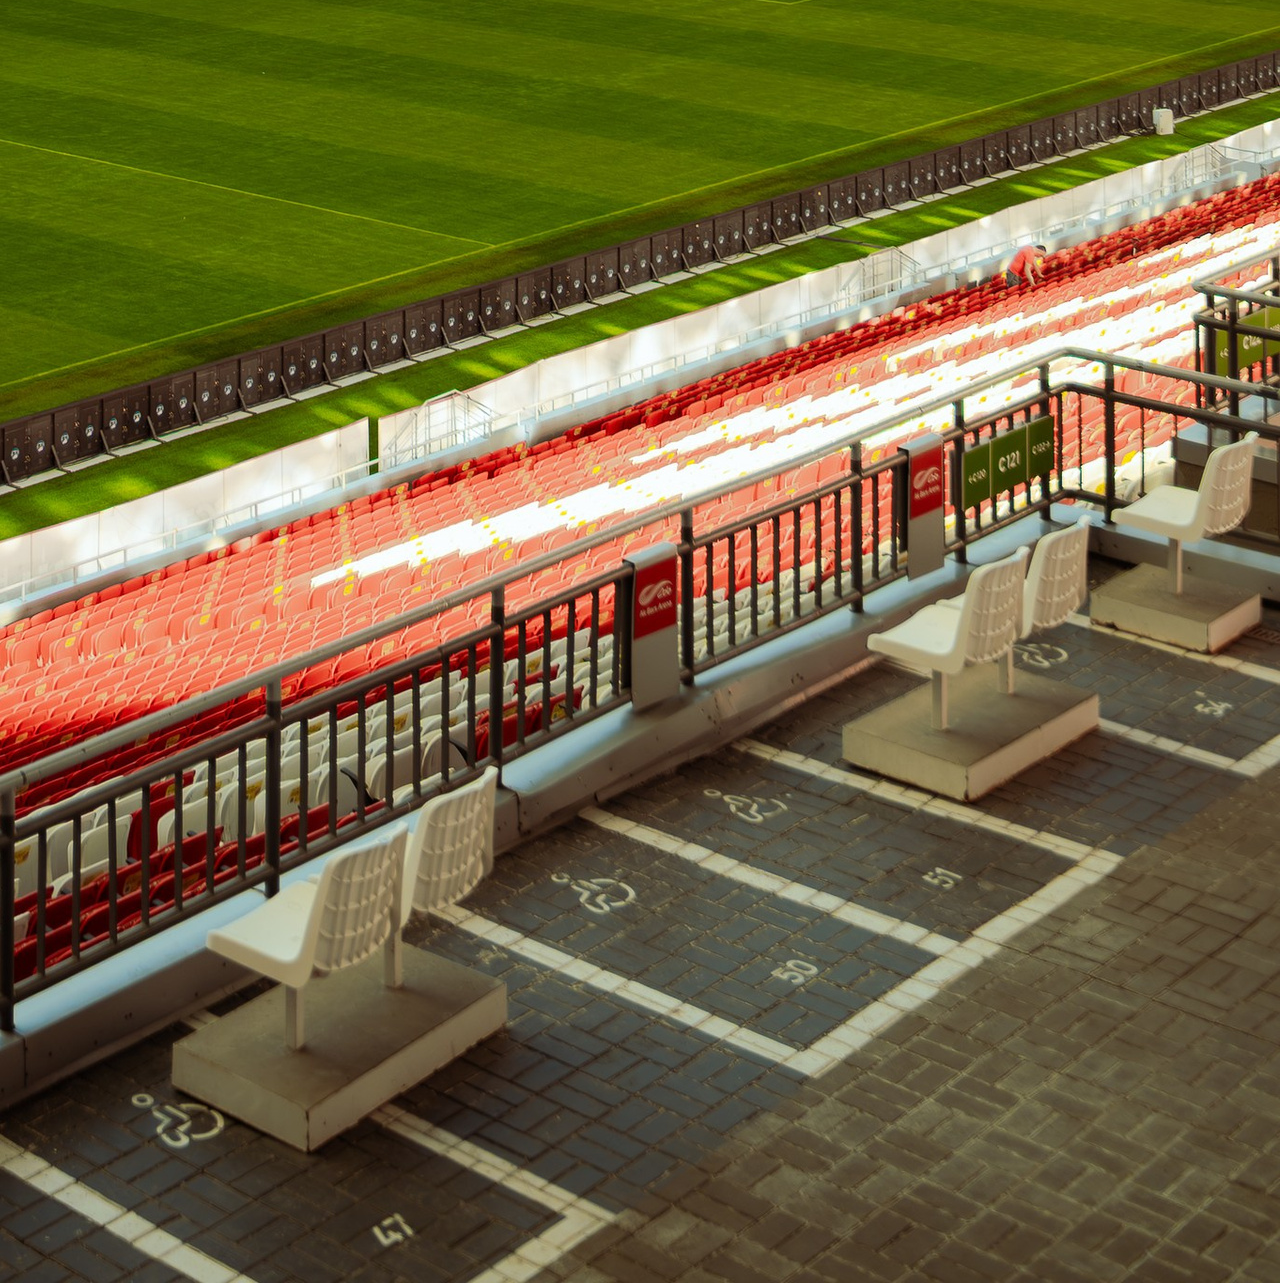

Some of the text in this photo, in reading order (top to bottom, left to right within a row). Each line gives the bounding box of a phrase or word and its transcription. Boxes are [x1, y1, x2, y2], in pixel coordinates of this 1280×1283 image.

[998, 450, 1020, 473] C121
[922, 867, 963, 890] 51
[770, 959, 818, 985] 50
[371, 1212, 414, 1248] 47
